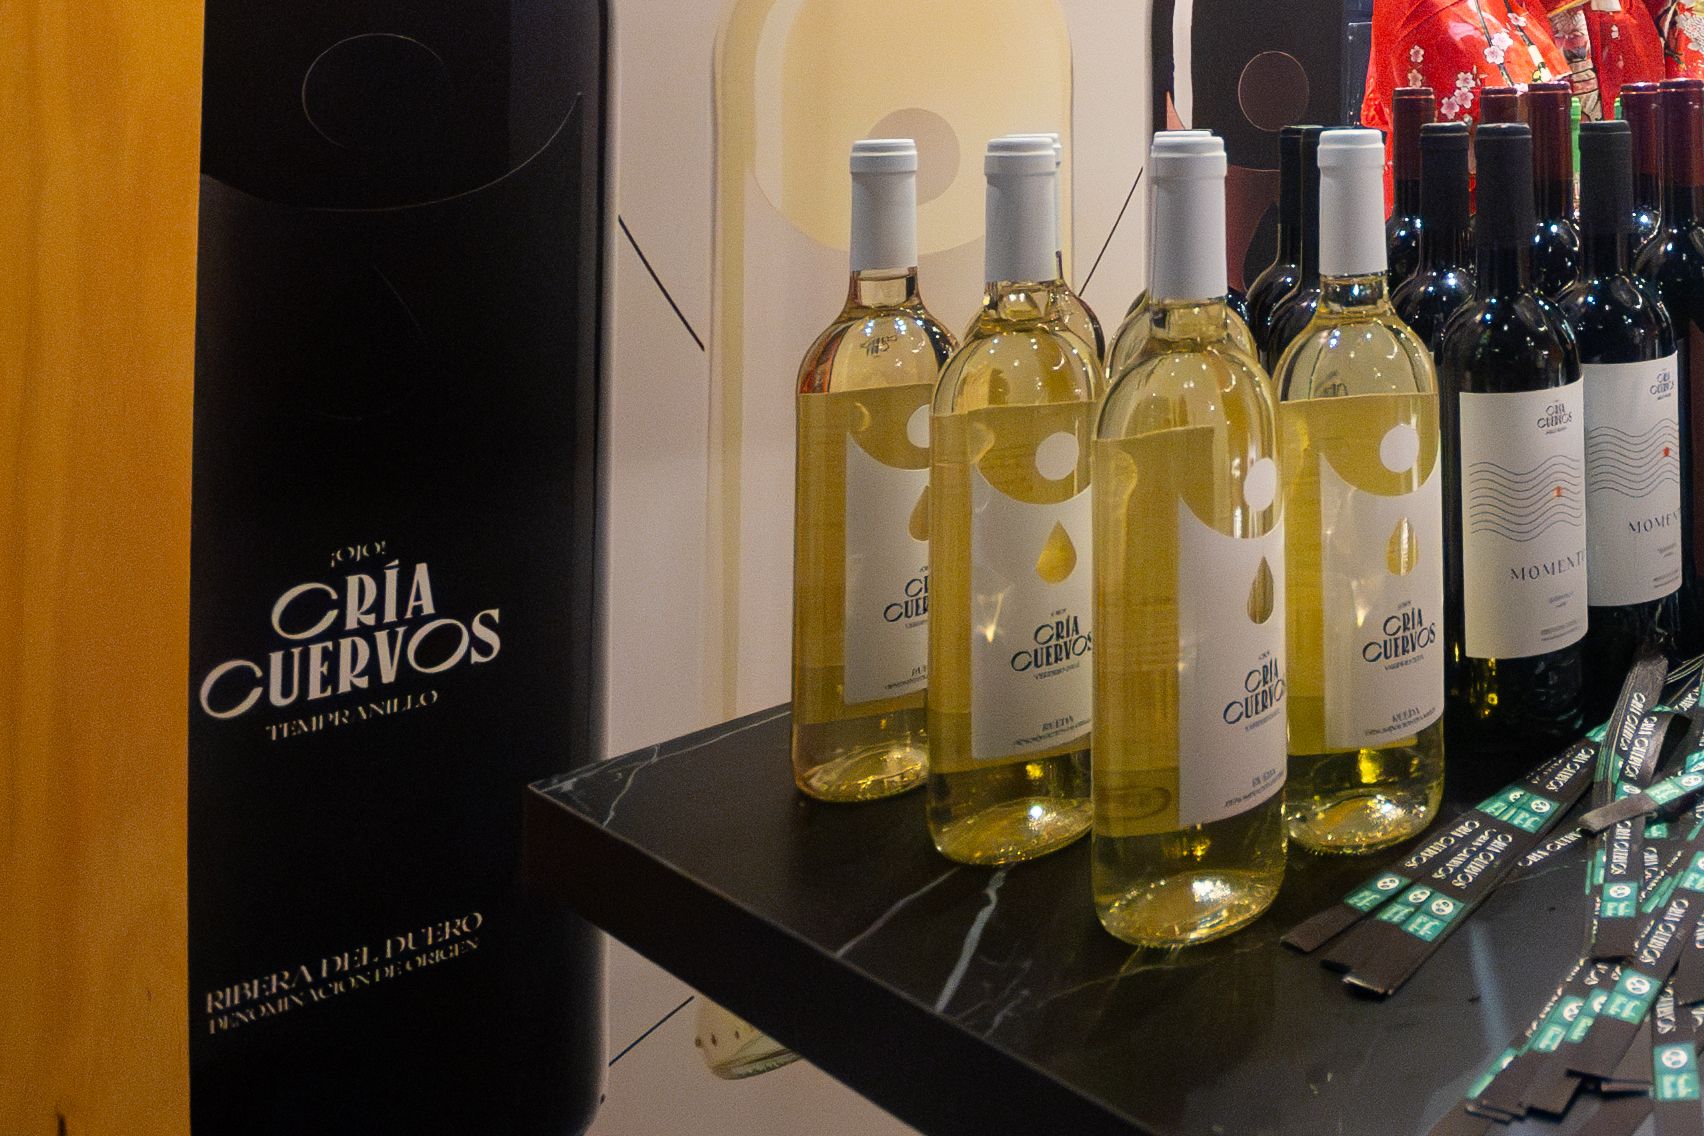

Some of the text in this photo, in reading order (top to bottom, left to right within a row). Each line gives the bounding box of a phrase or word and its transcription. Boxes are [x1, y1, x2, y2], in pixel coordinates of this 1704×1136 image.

[1510, 551, 1584, 581] MOMENT
[271, 559, 436, 640] CRÍA
[200, 608, 501, 719] CUERVOS
[1362, 622, 1436, 663] CUERVOS
[265, 690, 438, 741] TEMPRANILLO
[1223, 679, 1285, 725] CUERVO
[206, 912, 484, 1014] RIBERA DEL DUERO
